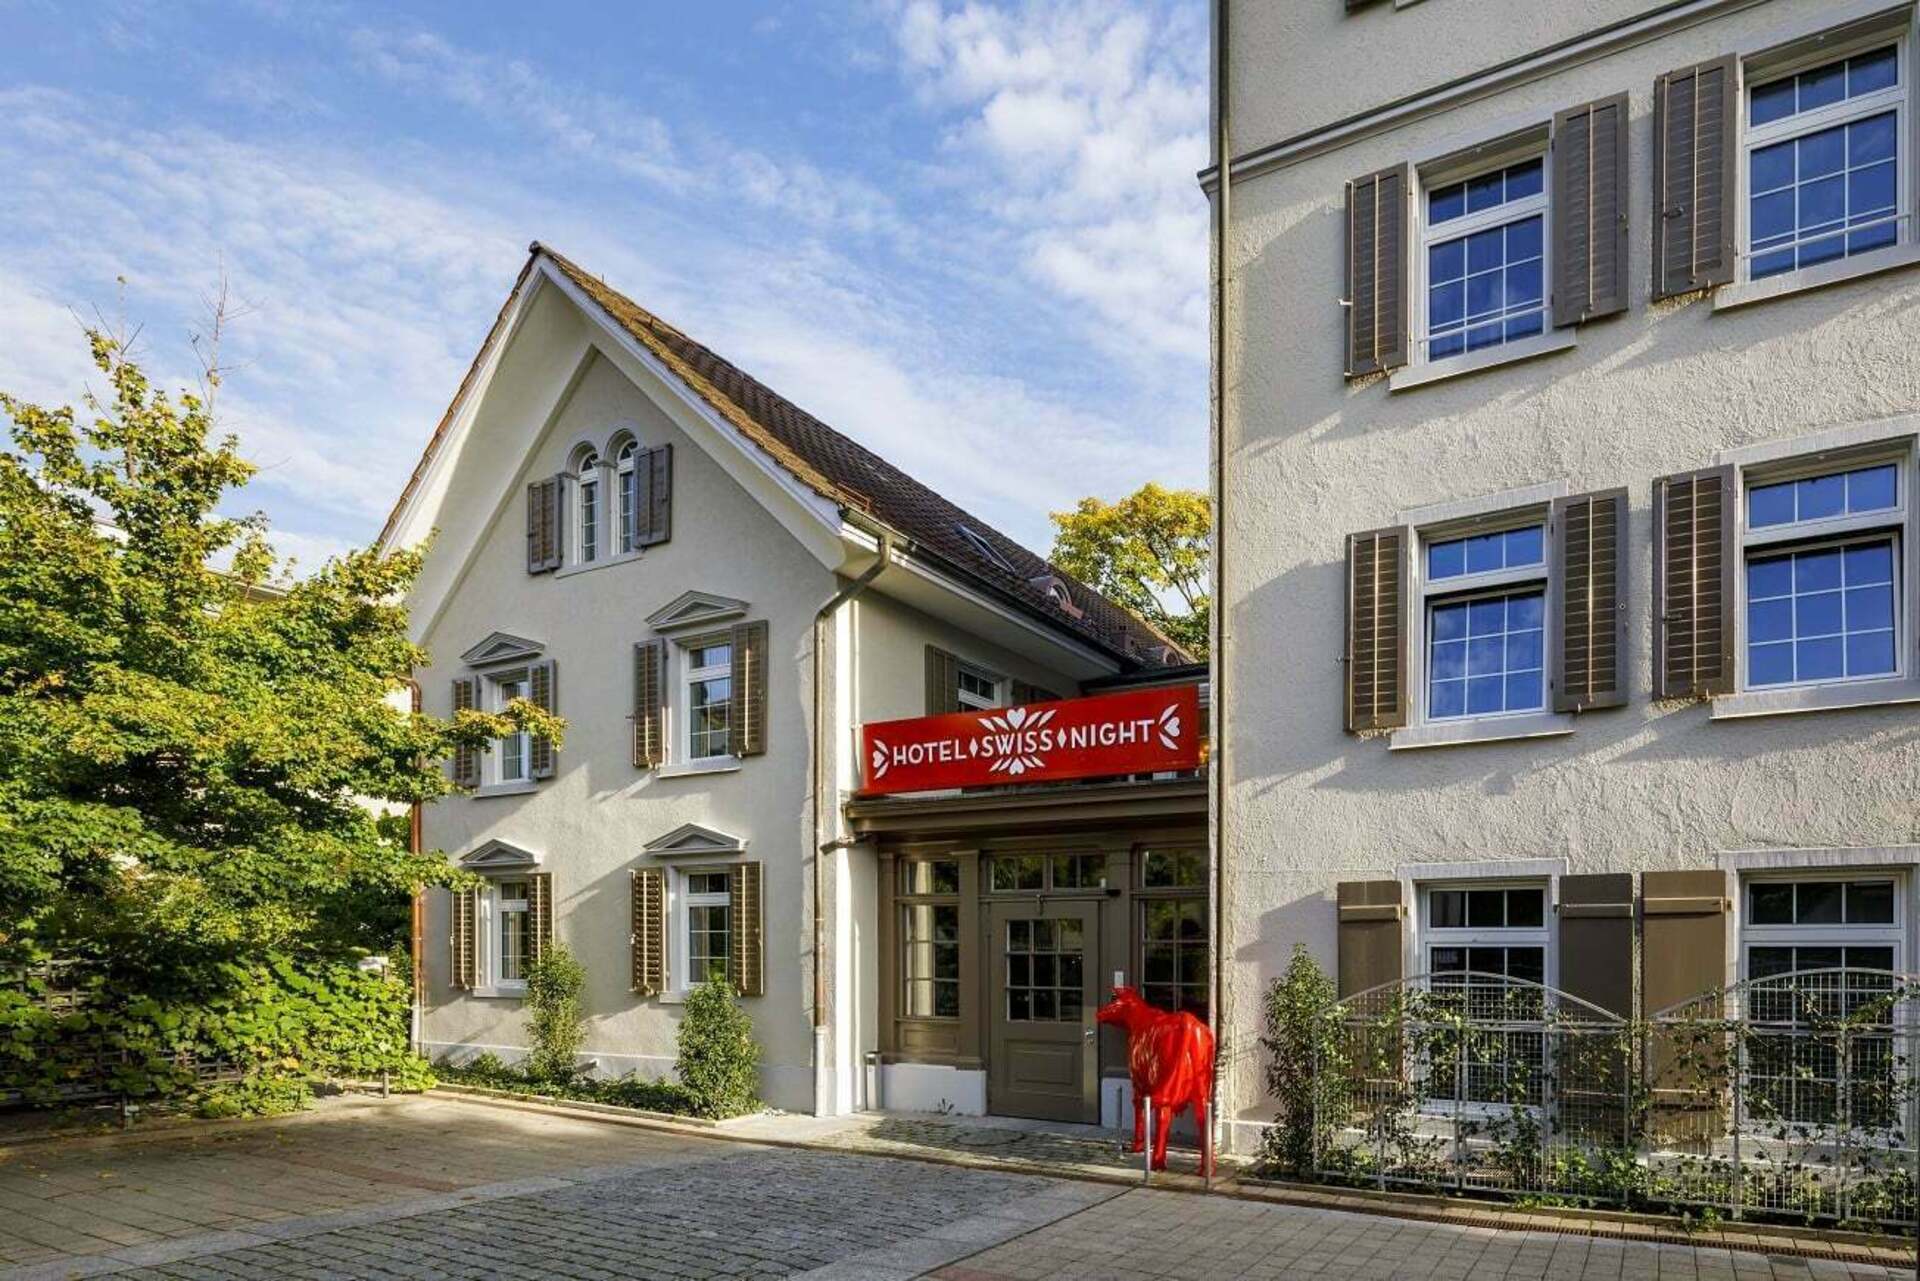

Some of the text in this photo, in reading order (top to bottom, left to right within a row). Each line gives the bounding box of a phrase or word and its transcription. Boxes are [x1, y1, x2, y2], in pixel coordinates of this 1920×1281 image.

[893, 719, 1155, 766] HOTEL SWISS NIGHT
